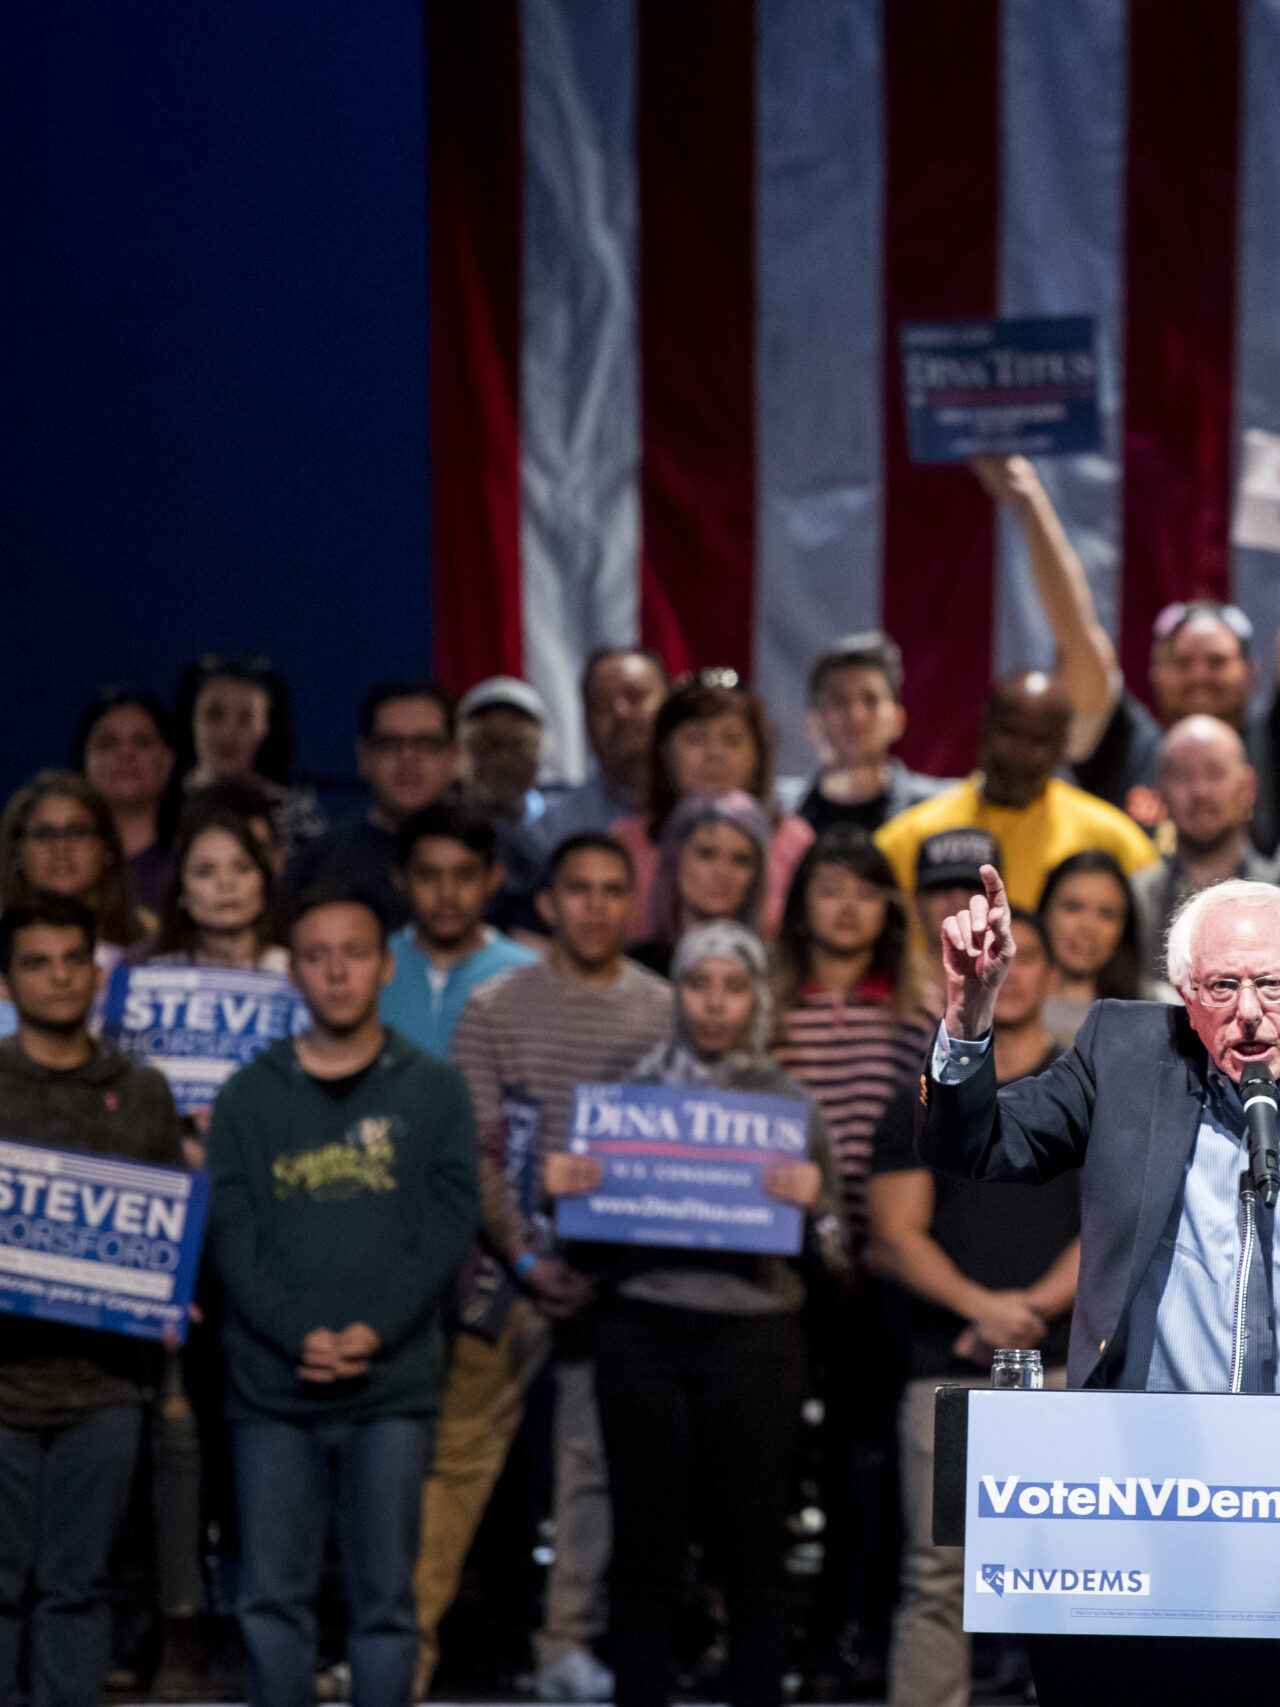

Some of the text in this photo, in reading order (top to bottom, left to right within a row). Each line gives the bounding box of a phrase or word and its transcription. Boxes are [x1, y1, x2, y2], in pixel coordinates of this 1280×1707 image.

[575, 1097, 807, 1150] DINA TITUS
[0, 1171, 186, 1241] STEVEN
[0, 1216, 180, 1274] ORSFORD
[1012, 1568, 1143, 1593] NVDEMS
